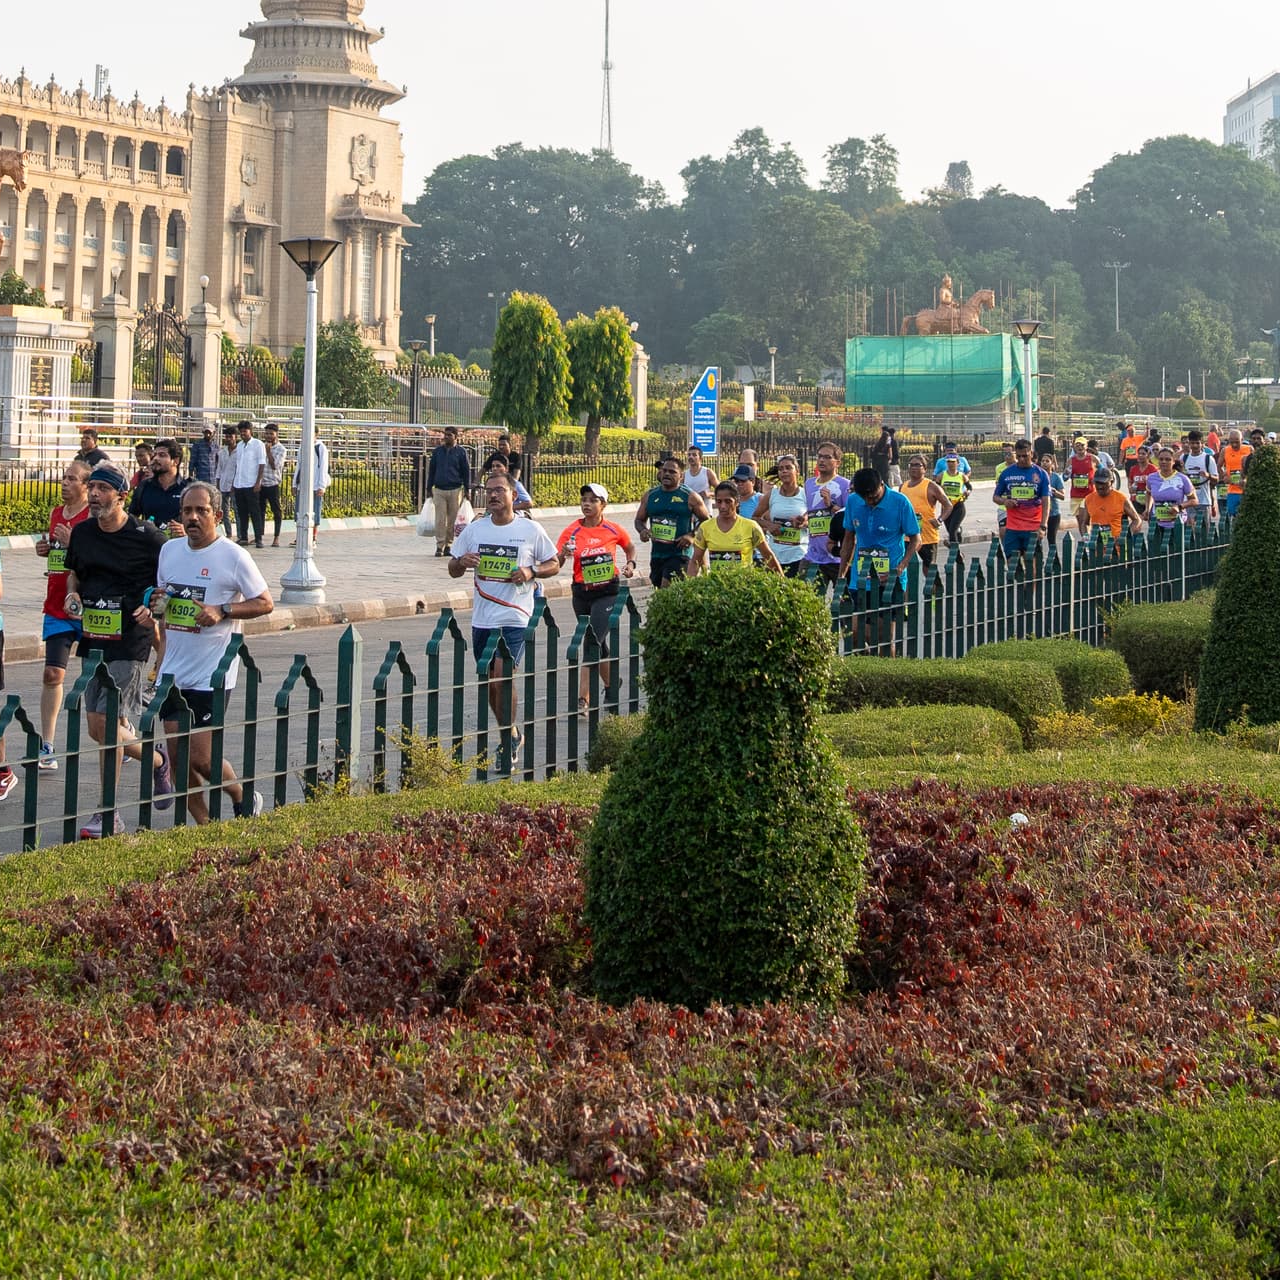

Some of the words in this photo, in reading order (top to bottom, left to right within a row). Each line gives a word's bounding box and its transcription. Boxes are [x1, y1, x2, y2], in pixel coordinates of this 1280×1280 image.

[483, 560, 511, 571] 17478
[587, 566, 611, 577] 11519
[88, 614, 112, 626] 9373
